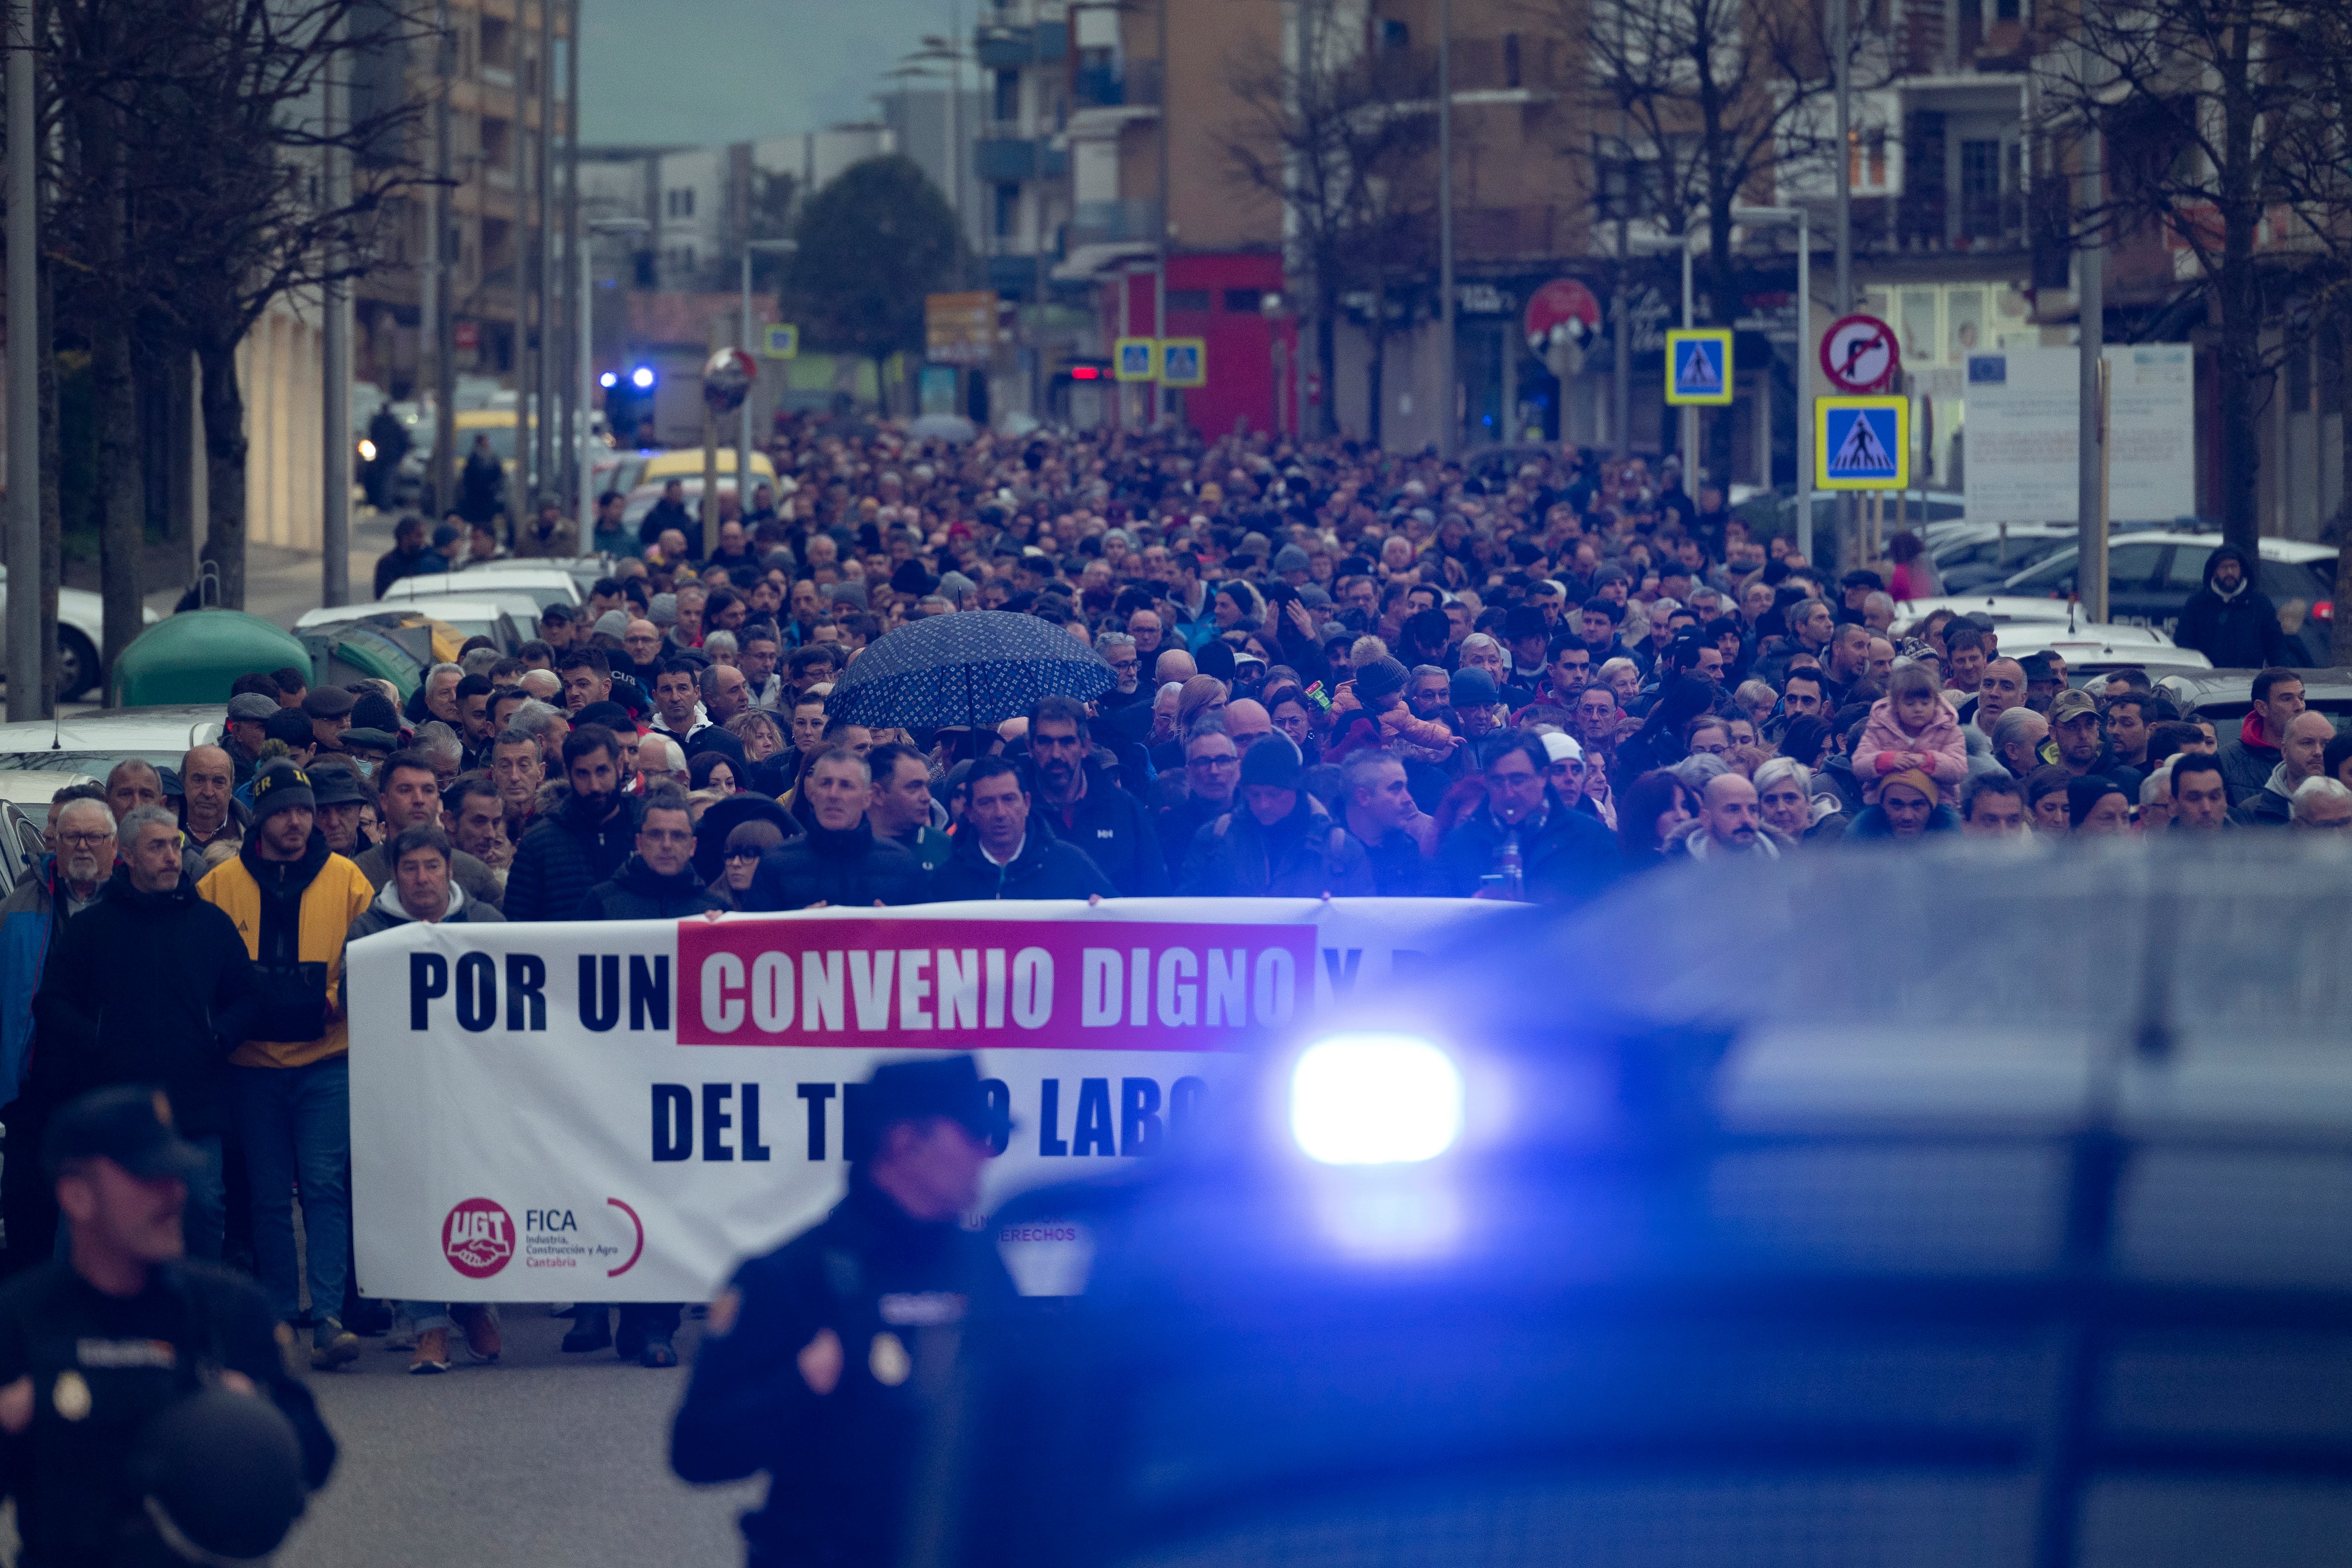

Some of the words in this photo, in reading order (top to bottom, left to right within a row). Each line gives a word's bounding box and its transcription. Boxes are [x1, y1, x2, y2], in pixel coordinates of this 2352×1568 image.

[255, 776, 271, 797] ER
[410, 951, 546, 1032] POR
[578, 954, 669, 1032] UN
[700, 946, 1055, 1034] CONVENIO
[1081, 946, 1295, 1029] DIGNO
[651, 1082, 770, 1162] DEL
[1039, 1075, 1210, 1157] LABO
[452, 1211, 506, 1242] UGT
[526, 1209, 578, 1231] FICA
[996, 1228, 1076, 1242] ERECHOS
[526, 1244, 585, 1255] Construcción
[588, 1247, 594, 1256] y
[596, 1244, 619, 1258] Agro
[526, 1256, 577, 1268] Cantabria
